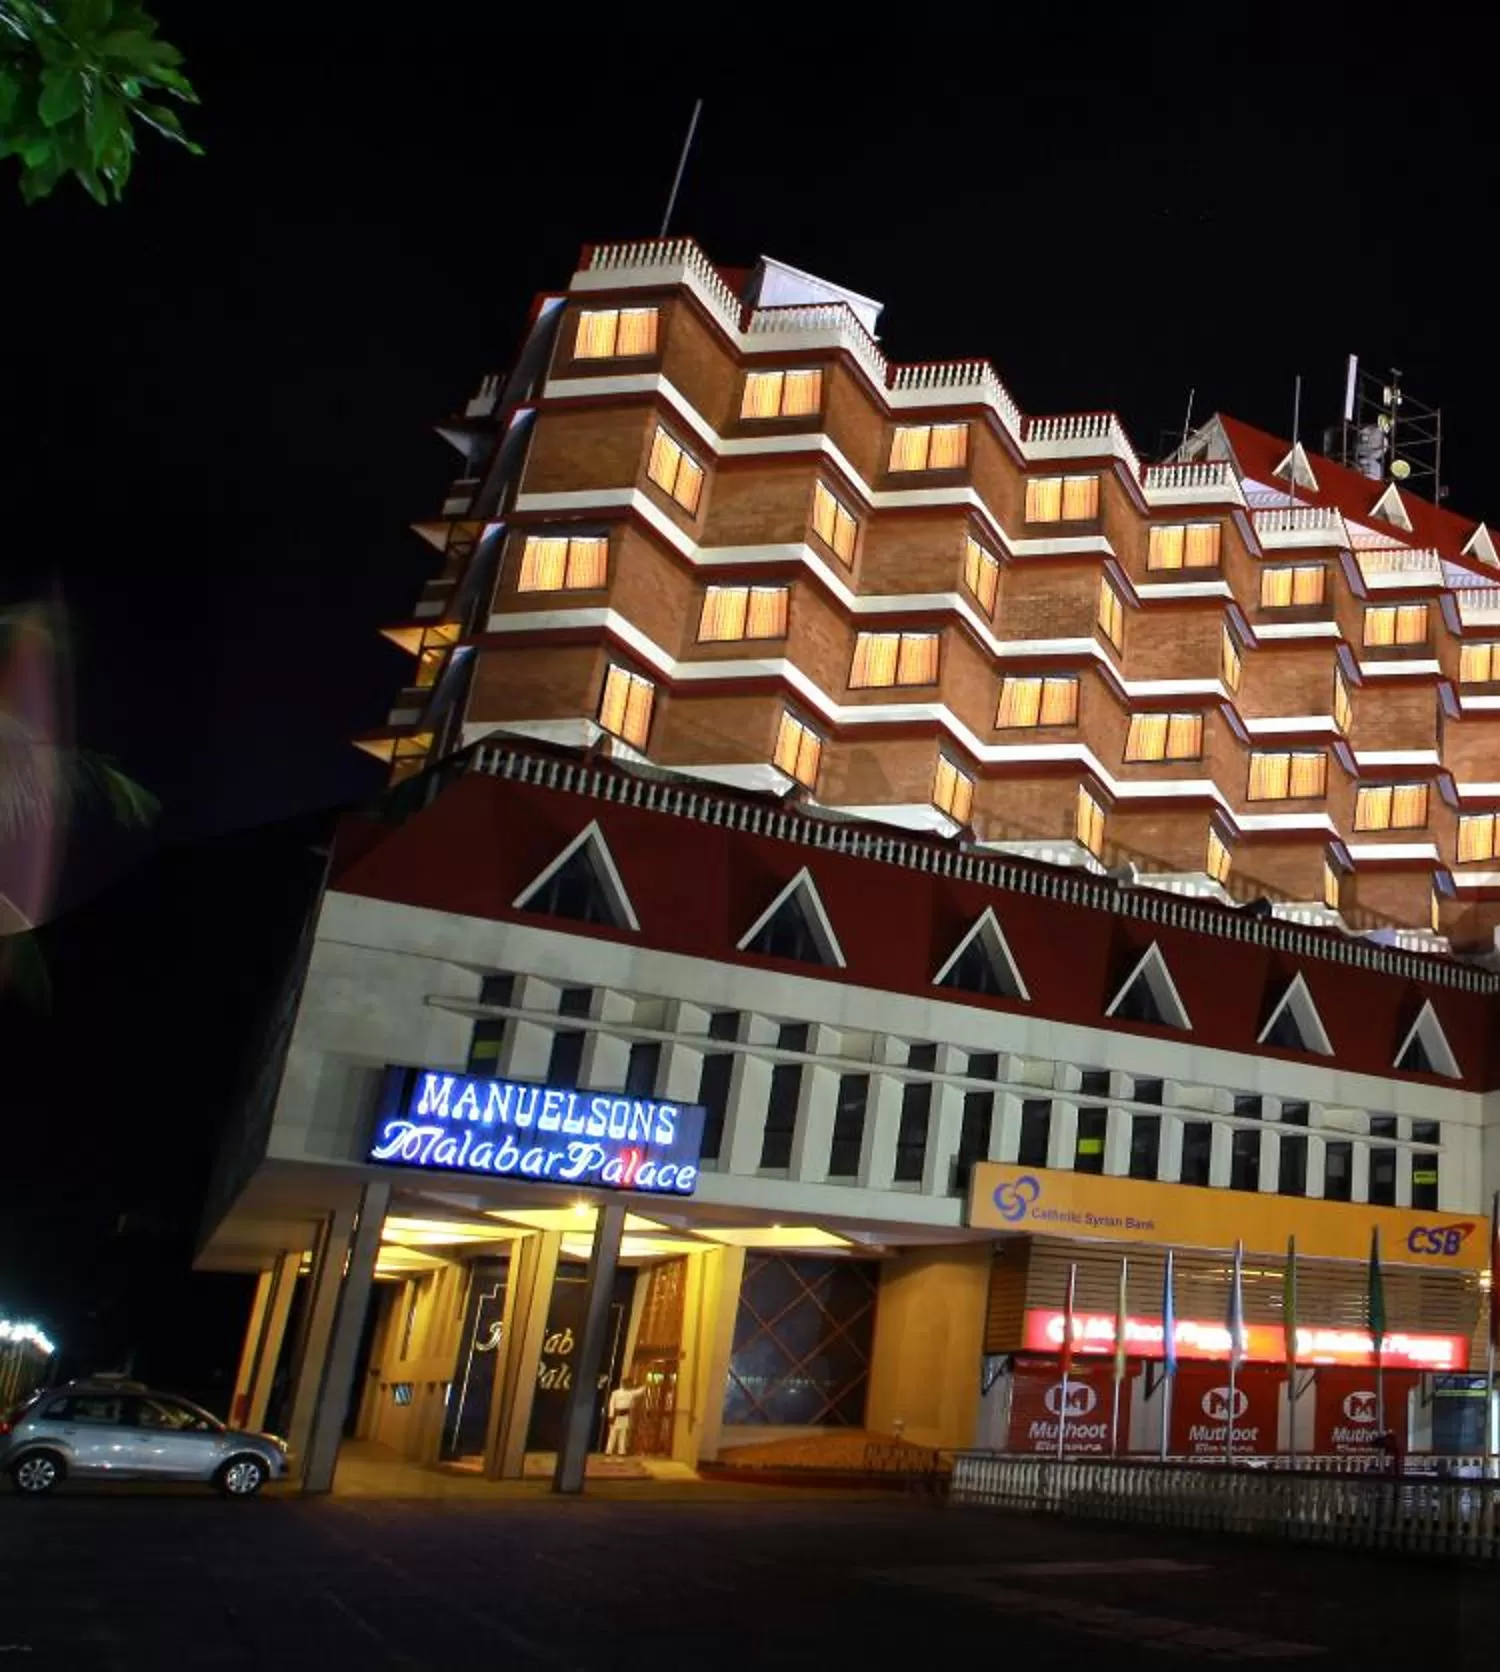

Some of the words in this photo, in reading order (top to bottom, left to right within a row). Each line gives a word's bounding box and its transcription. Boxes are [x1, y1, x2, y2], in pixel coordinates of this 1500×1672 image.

[416, 1073, 678, 1145] MANUELSONS
[371, 1120, 564, 1176] Malabar
[559, 1140, 697, 1190] Palace
[1031, 1206, 1083, 1225] Catholic
[1085, 1211, 1123, 1228] Syrian
[1125, 1216, 1155, 1231] Bank
[1407, 1226, 1462, 1256] CSB
[1332, 1427, 1394, 1443] Mutho
